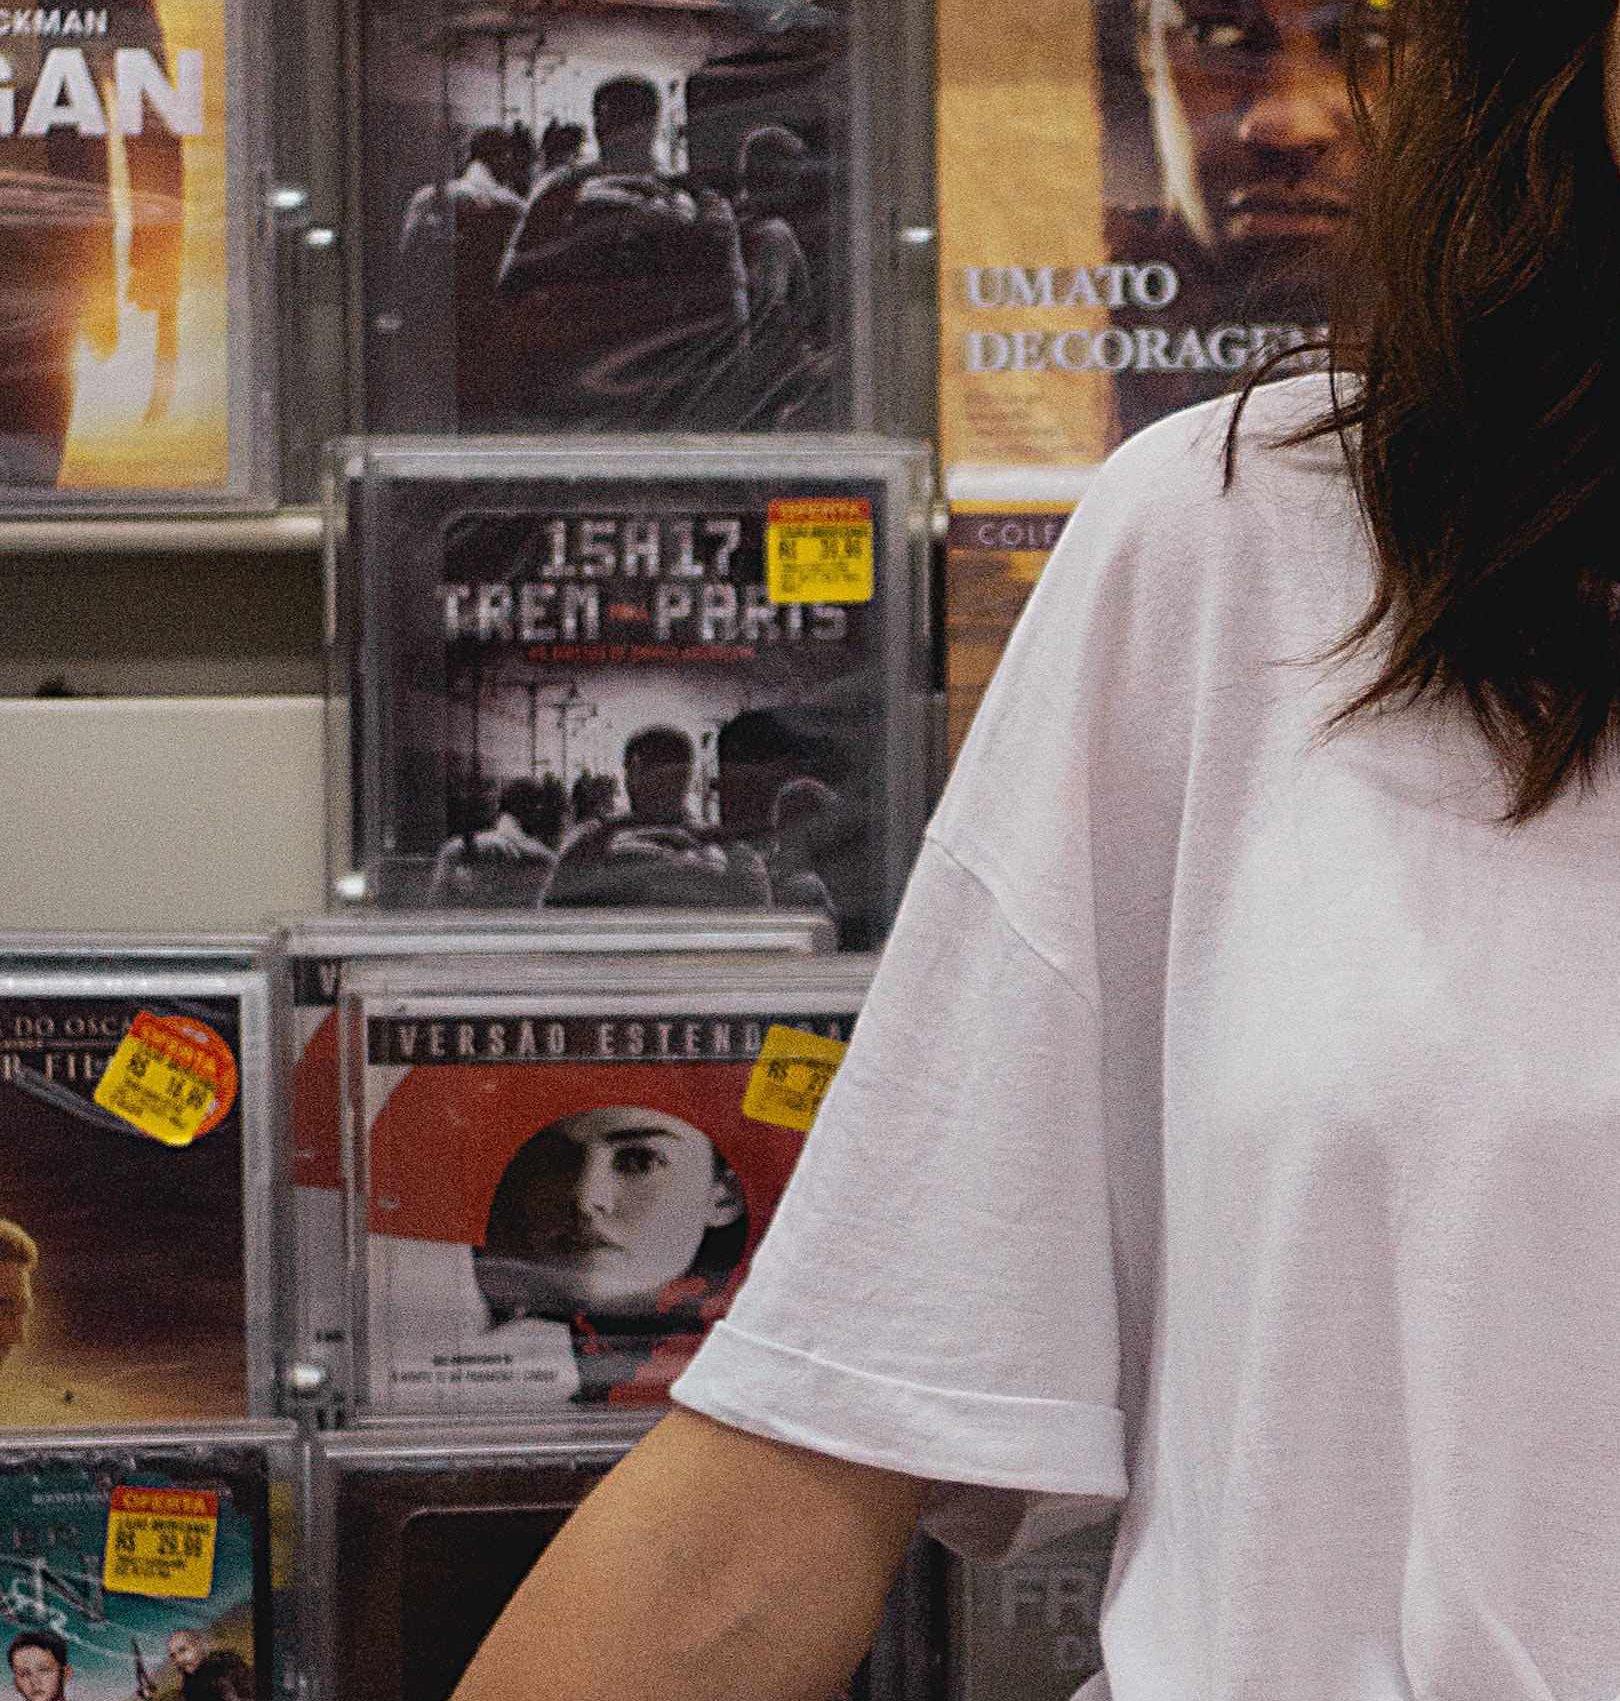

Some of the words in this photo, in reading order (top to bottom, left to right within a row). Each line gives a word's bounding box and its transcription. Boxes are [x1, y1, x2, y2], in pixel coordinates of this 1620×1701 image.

[0, 46, 204, 137] AN
[542, 519, 742, 578] 15H17
[435, 583, 601, 642] TREM
[14, 1016, 54, 1037] DO
[399, 1019, 565, 1056] VERSÃO
[123, 1492, 208, 1513] OFERTA
